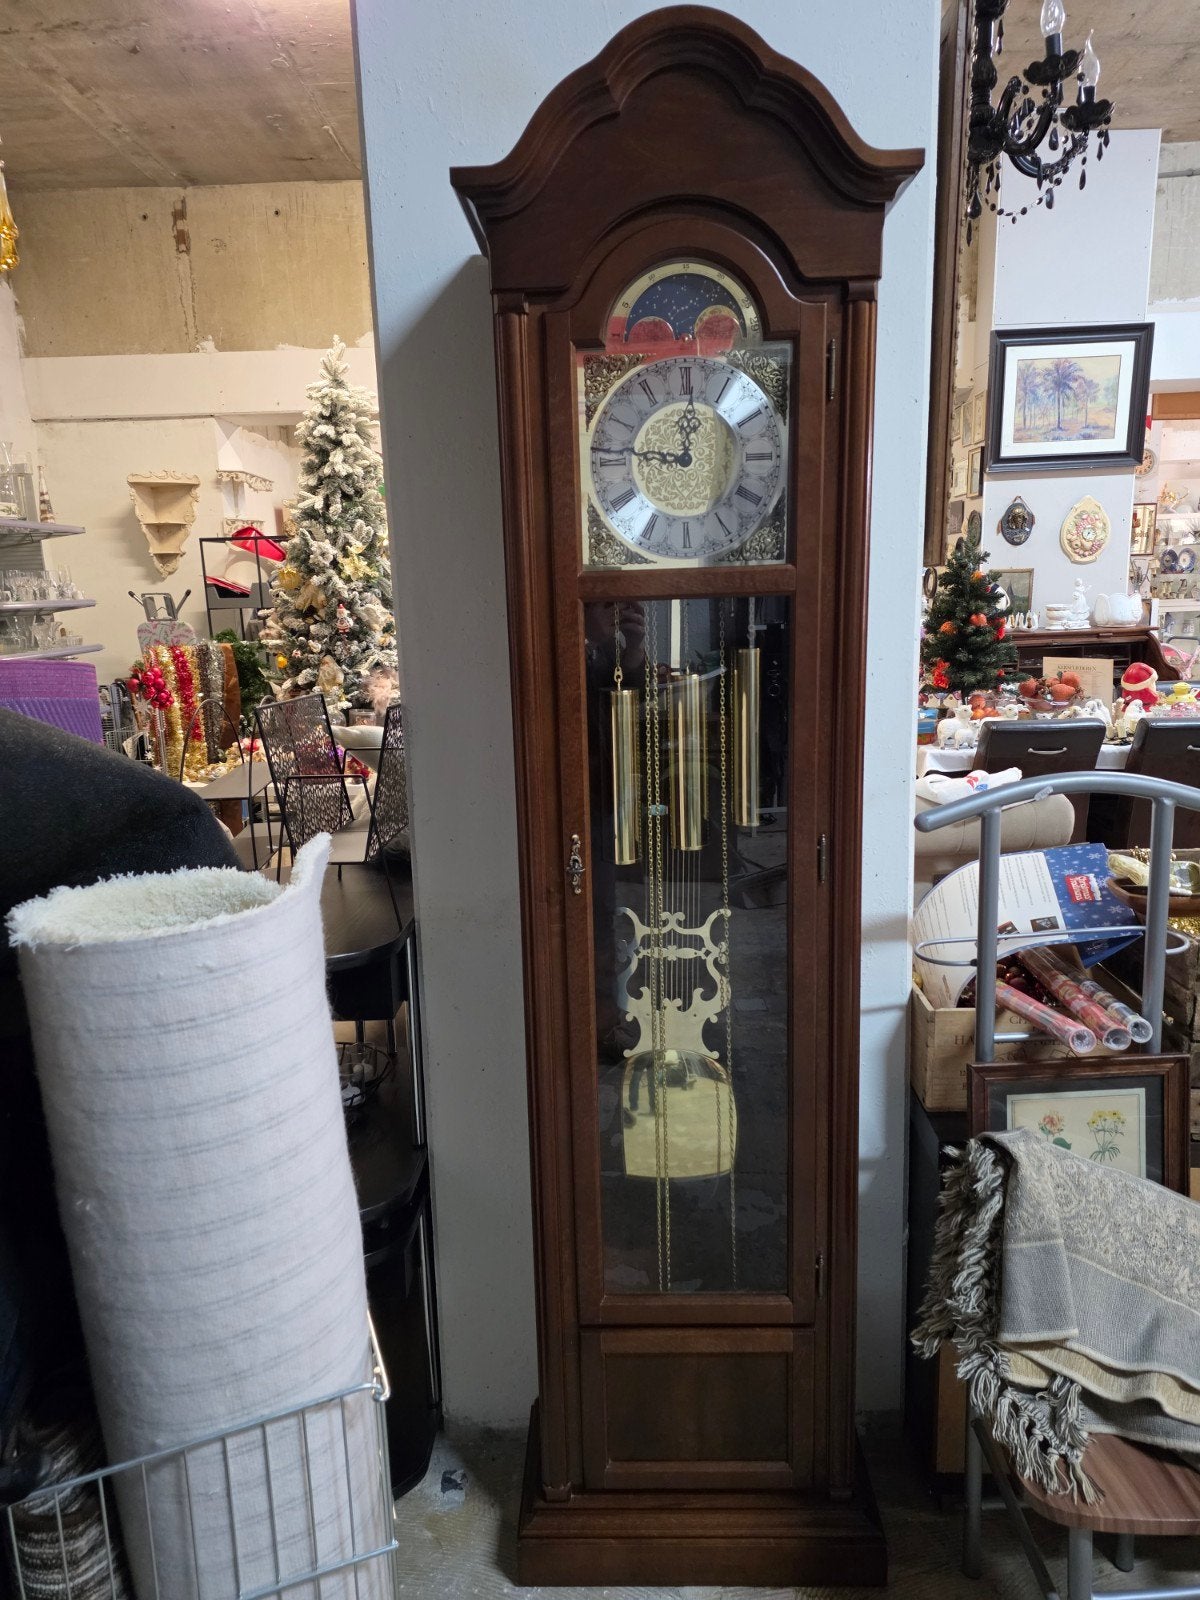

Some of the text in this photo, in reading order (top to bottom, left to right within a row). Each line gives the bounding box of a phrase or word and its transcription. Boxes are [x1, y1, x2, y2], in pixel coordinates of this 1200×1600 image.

[638, 379, 659, 408] XI
[679, 366, 693, 396] XII
[737, 408, 762, 428] II
[599, 456, 627, 468] IX
[745, 451, 773, 463] III
[639, 512, 659, 541] VII
[714, 512, 732, 538] V
